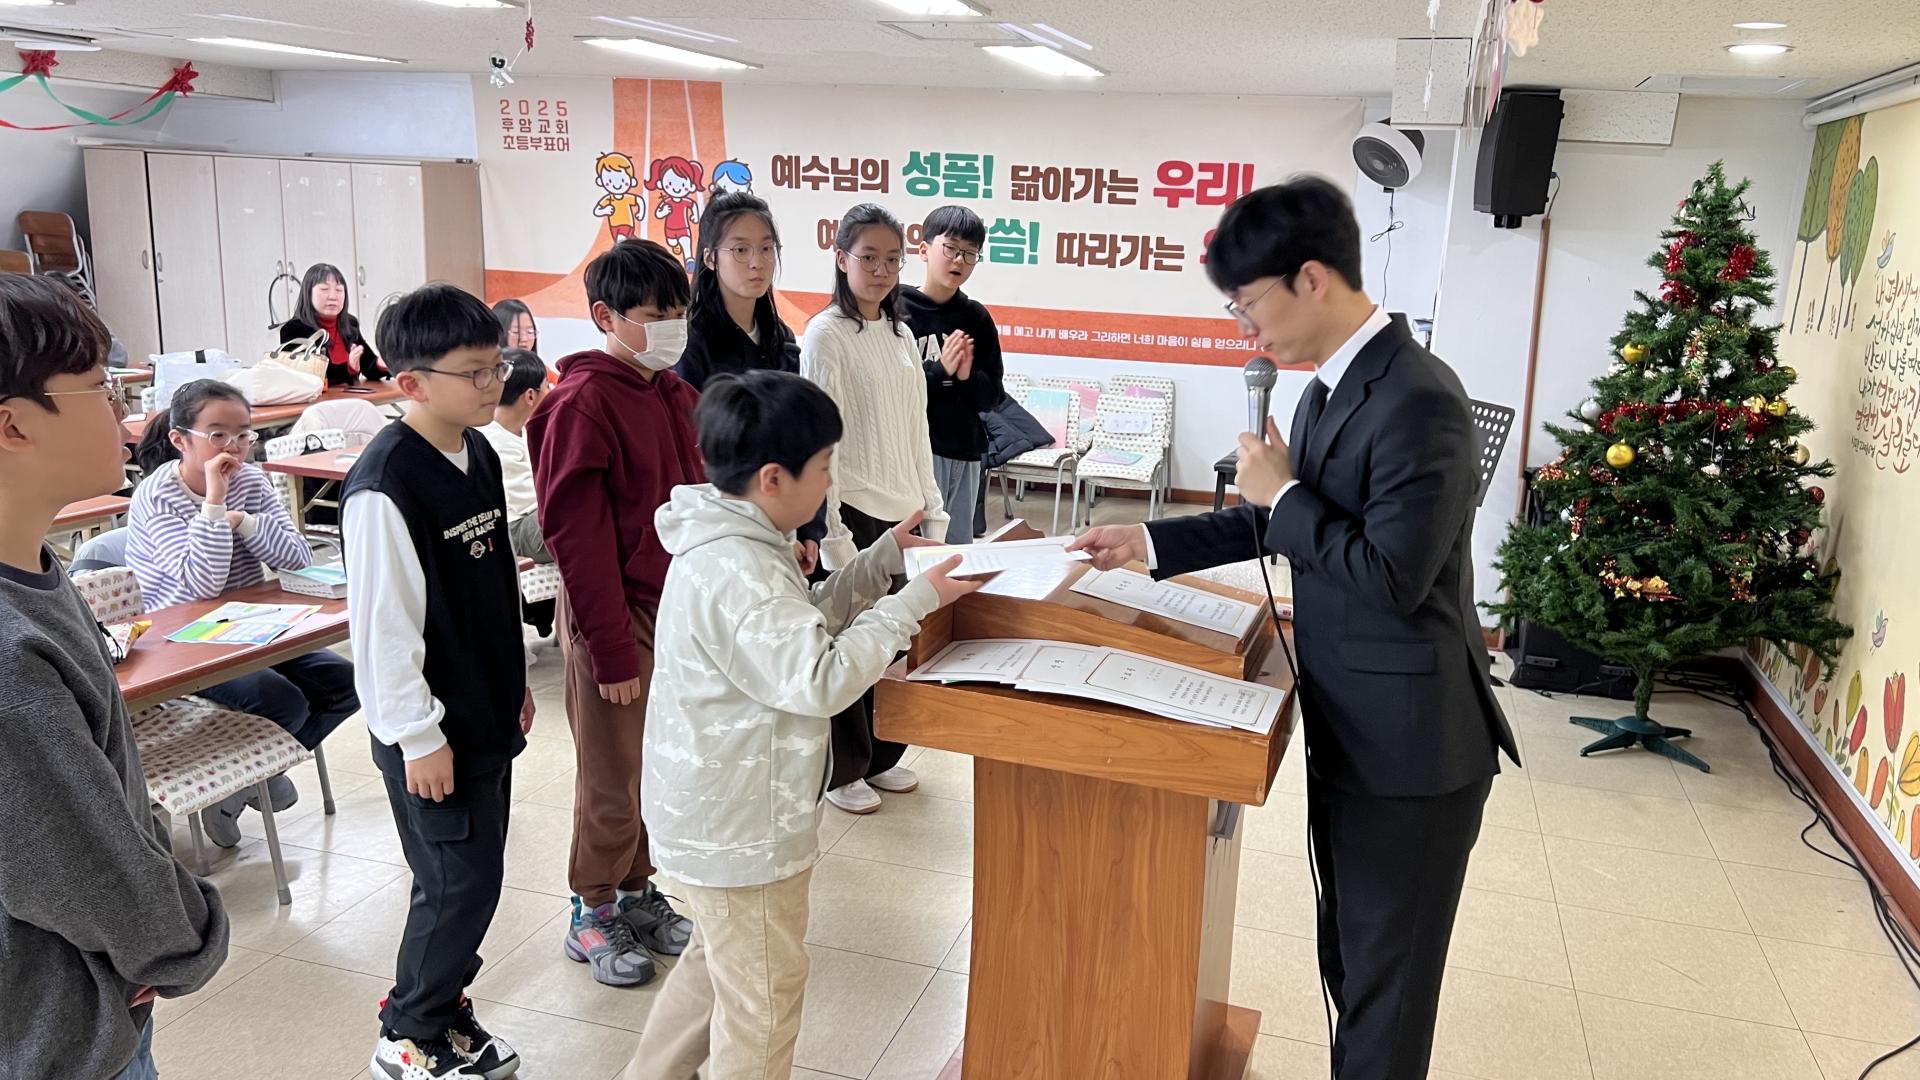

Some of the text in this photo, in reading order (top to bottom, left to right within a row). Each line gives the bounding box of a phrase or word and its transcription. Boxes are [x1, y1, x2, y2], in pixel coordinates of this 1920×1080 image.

[500, 99, 567, 116] 2025
[771, 151, 1255, 208] 예수님의 성품! 닮아가는 우리!
[1056, 232, 1185, 272] 따라가는
[1059, 329, 1088, 342] 배우라
[1091, 331, 1131, 344] 그리하면
[1134, 333, 1154, 345] 너희
[1157, 335, 1188, 347] 마음이
